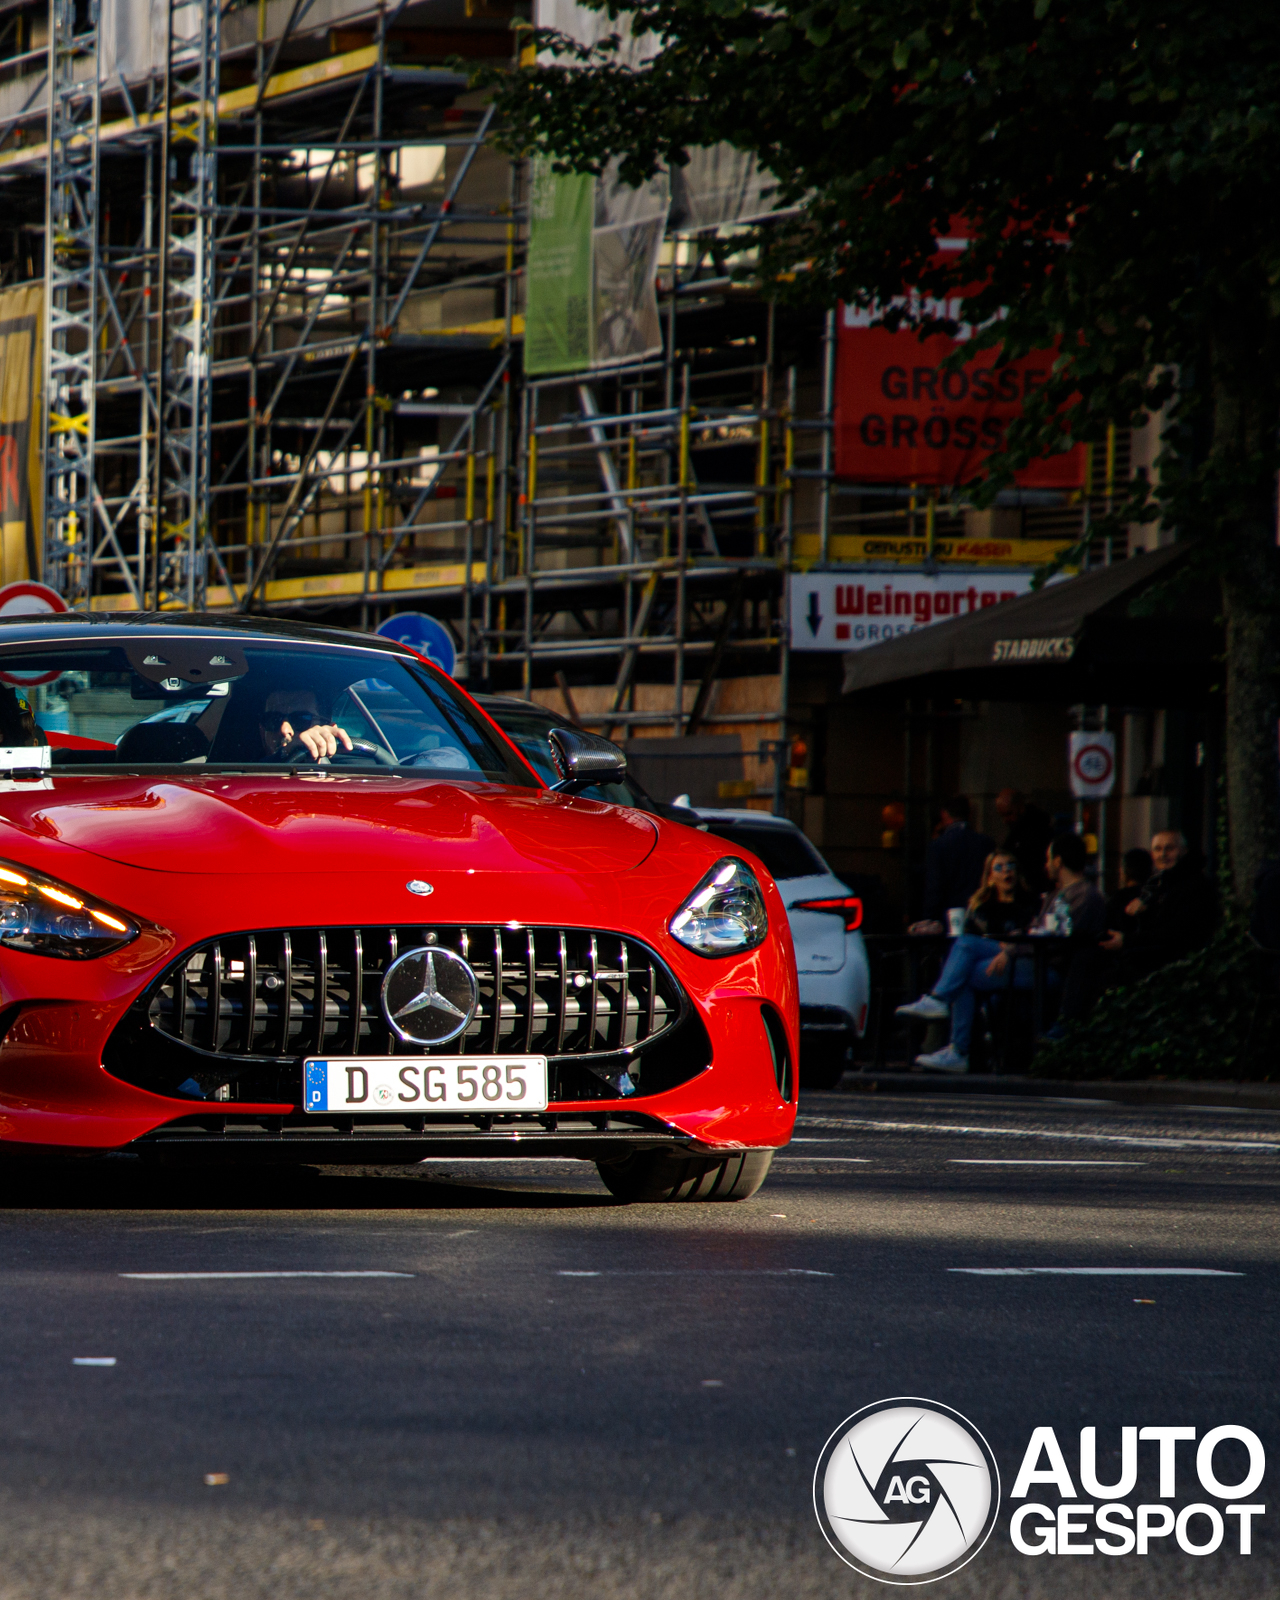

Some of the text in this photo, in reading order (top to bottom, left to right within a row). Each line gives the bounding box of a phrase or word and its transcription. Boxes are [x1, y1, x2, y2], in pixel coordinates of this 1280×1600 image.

[859, 406, 1012, 450] GRÖSS
[991, 636, 1075, 662] STARBUCKS
[312, 1065, 527, 1103] D D SG 585
